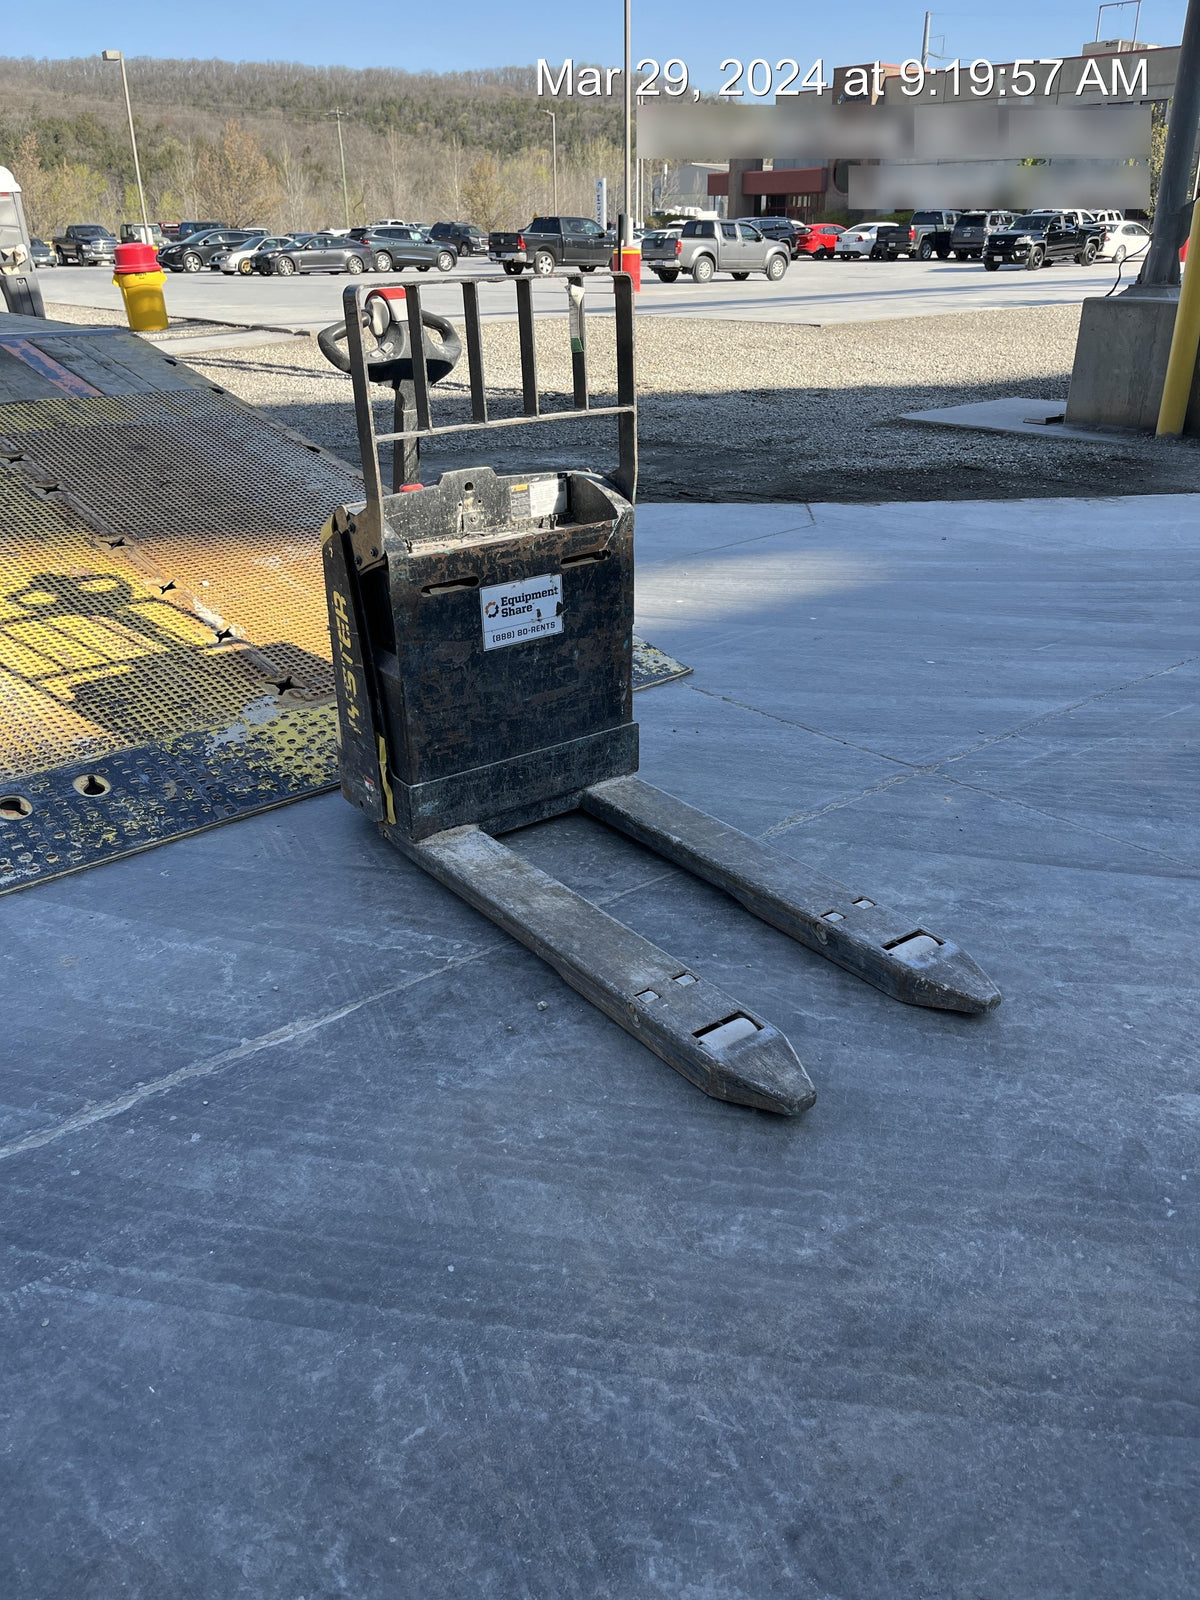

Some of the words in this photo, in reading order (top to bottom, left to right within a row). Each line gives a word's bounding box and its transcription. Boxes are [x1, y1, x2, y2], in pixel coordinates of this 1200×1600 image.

[501, 586, 559, 606] Equipment
[501, 604, 533, 618] Share
[492, 631, 515, 643] (888)
